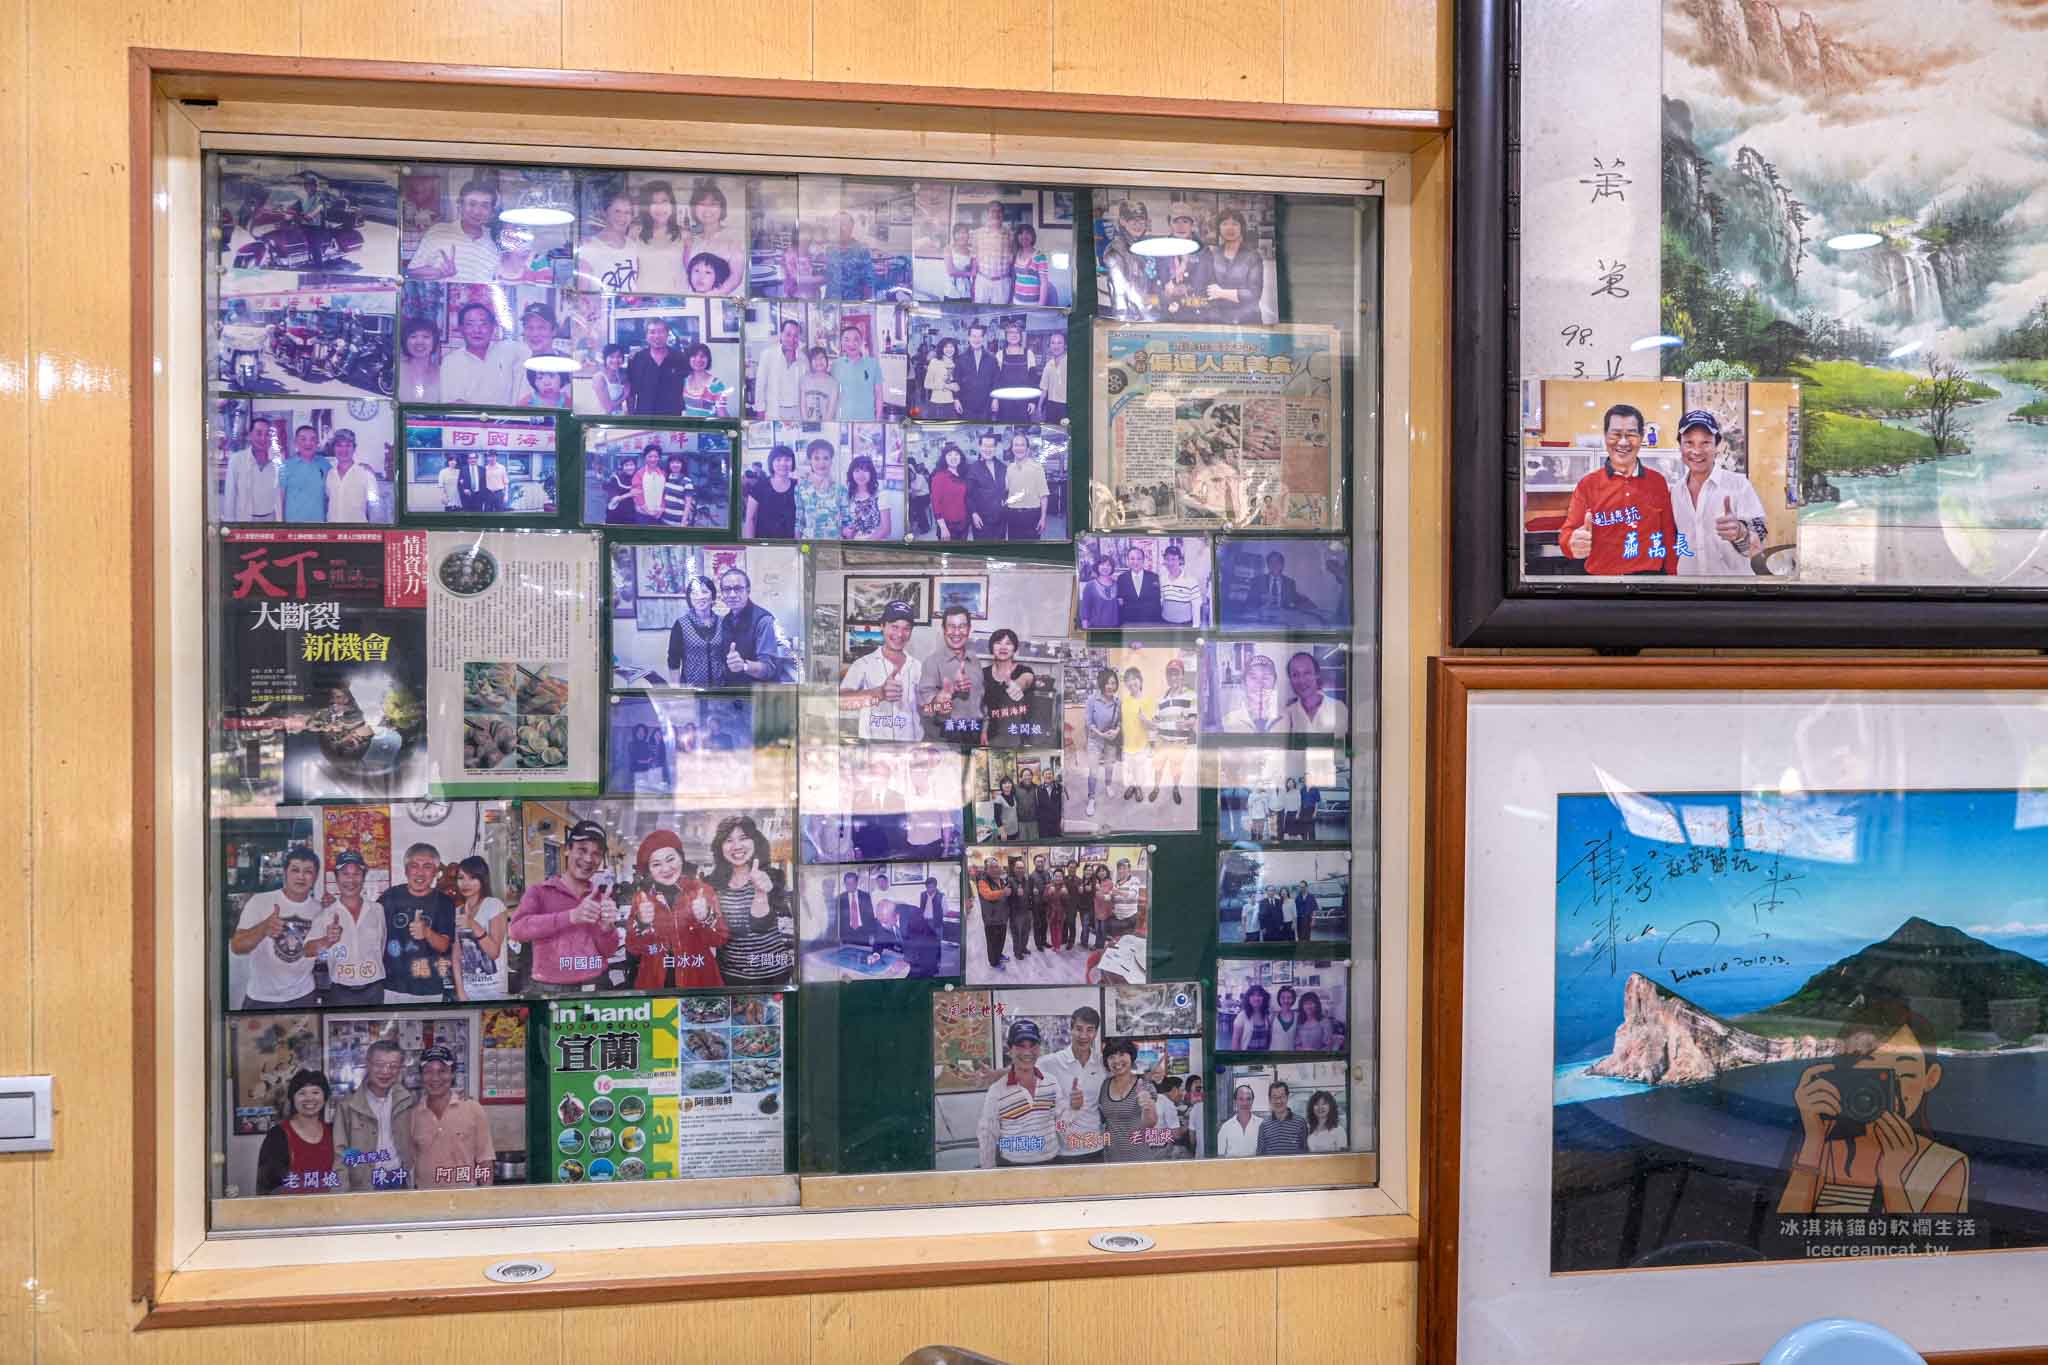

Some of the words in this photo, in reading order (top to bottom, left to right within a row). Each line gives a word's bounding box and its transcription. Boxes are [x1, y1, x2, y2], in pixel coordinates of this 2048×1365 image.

[1623, 531, 1696, 559] 蕭萬長
[232, 547, 328, 600] 天下
[403, 535, 421, 596] 情資力
[250, 602, 342, 632] 大斷裂
[302, 632, 392, 663] 新機會
[663, 952, 705, 968] 白冰冰
[552, 1002, 577, 1024] in
[583, 1002, 651, 1023] hand
[554, 1031, 641, 1073] 宜蘭
[283, 1171, 340, 1189] 老闆娘
[372, 1167, 409, 1185] 陳沖
[435, 1166, 491, 1184] 阿國師
